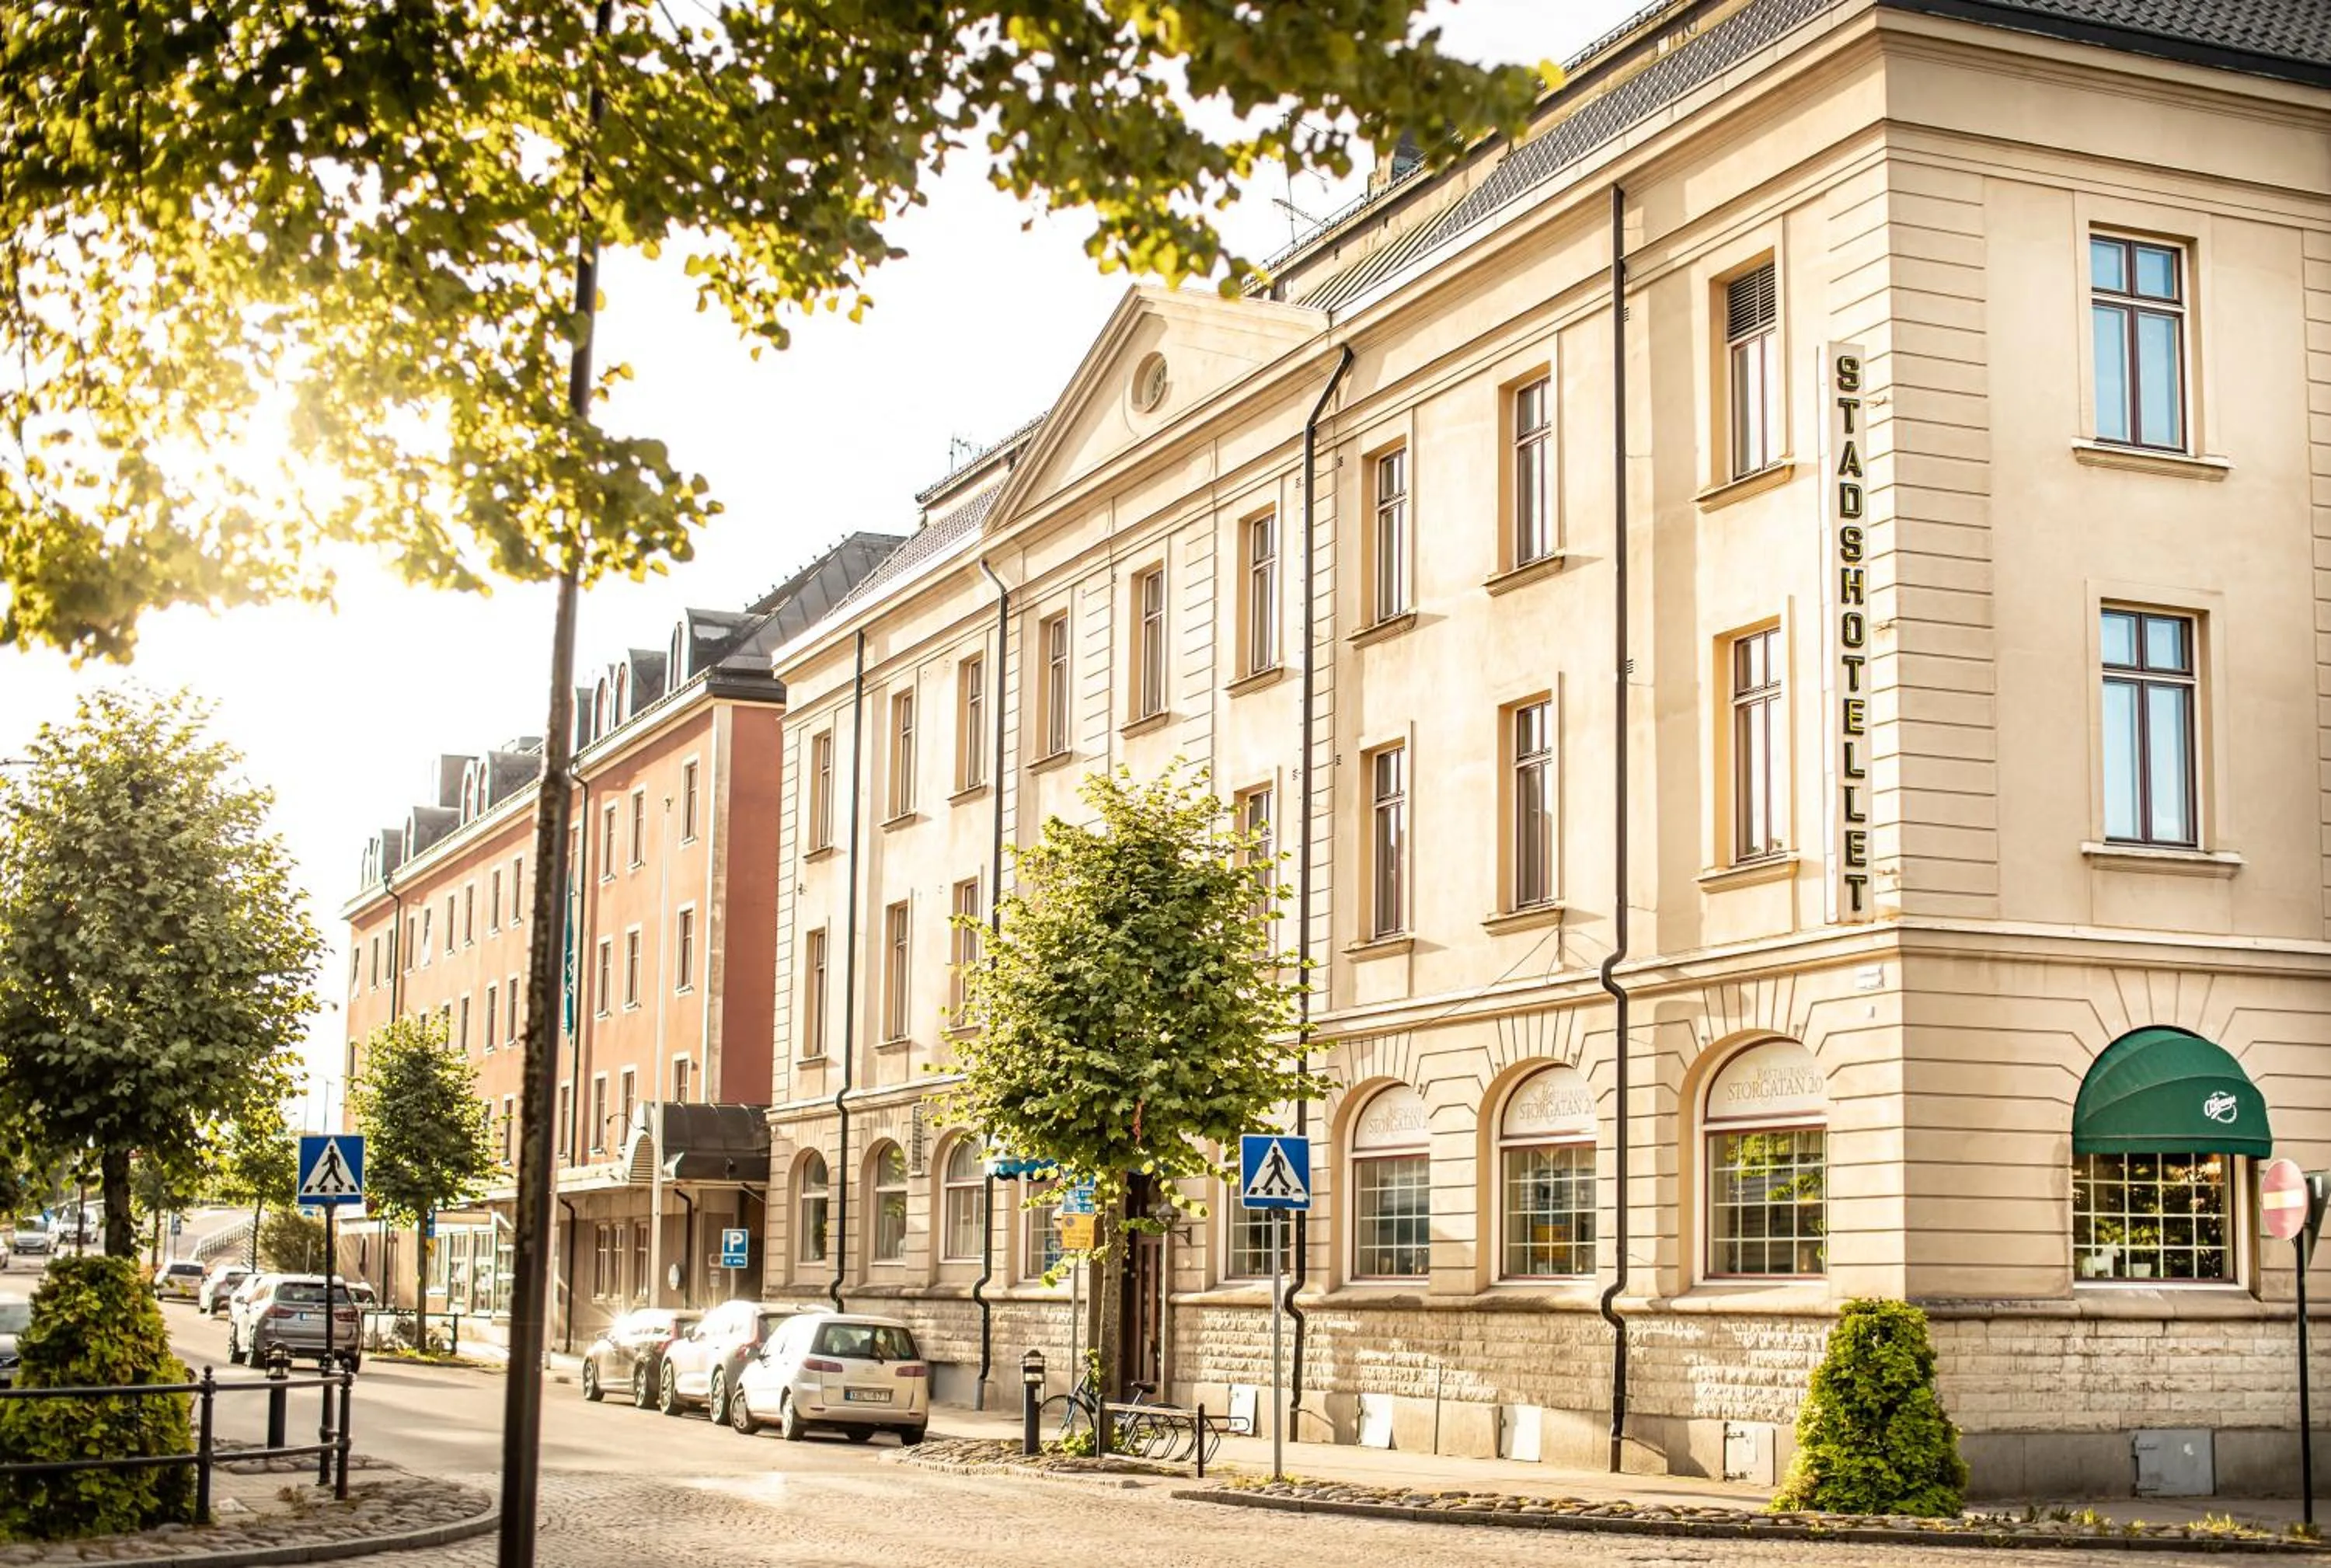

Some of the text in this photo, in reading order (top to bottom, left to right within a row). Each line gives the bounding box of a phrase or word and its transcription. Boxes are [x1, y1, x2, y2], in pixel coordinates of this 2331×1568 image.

[1836, 355, 1868, 911] STADSHOTELLET
[1727, 1075, 1824, 1101] STORGATAN 20
[1519, 1096, 1582, 1120] STORGATAN
[729, 1232, 744, 1252] P
